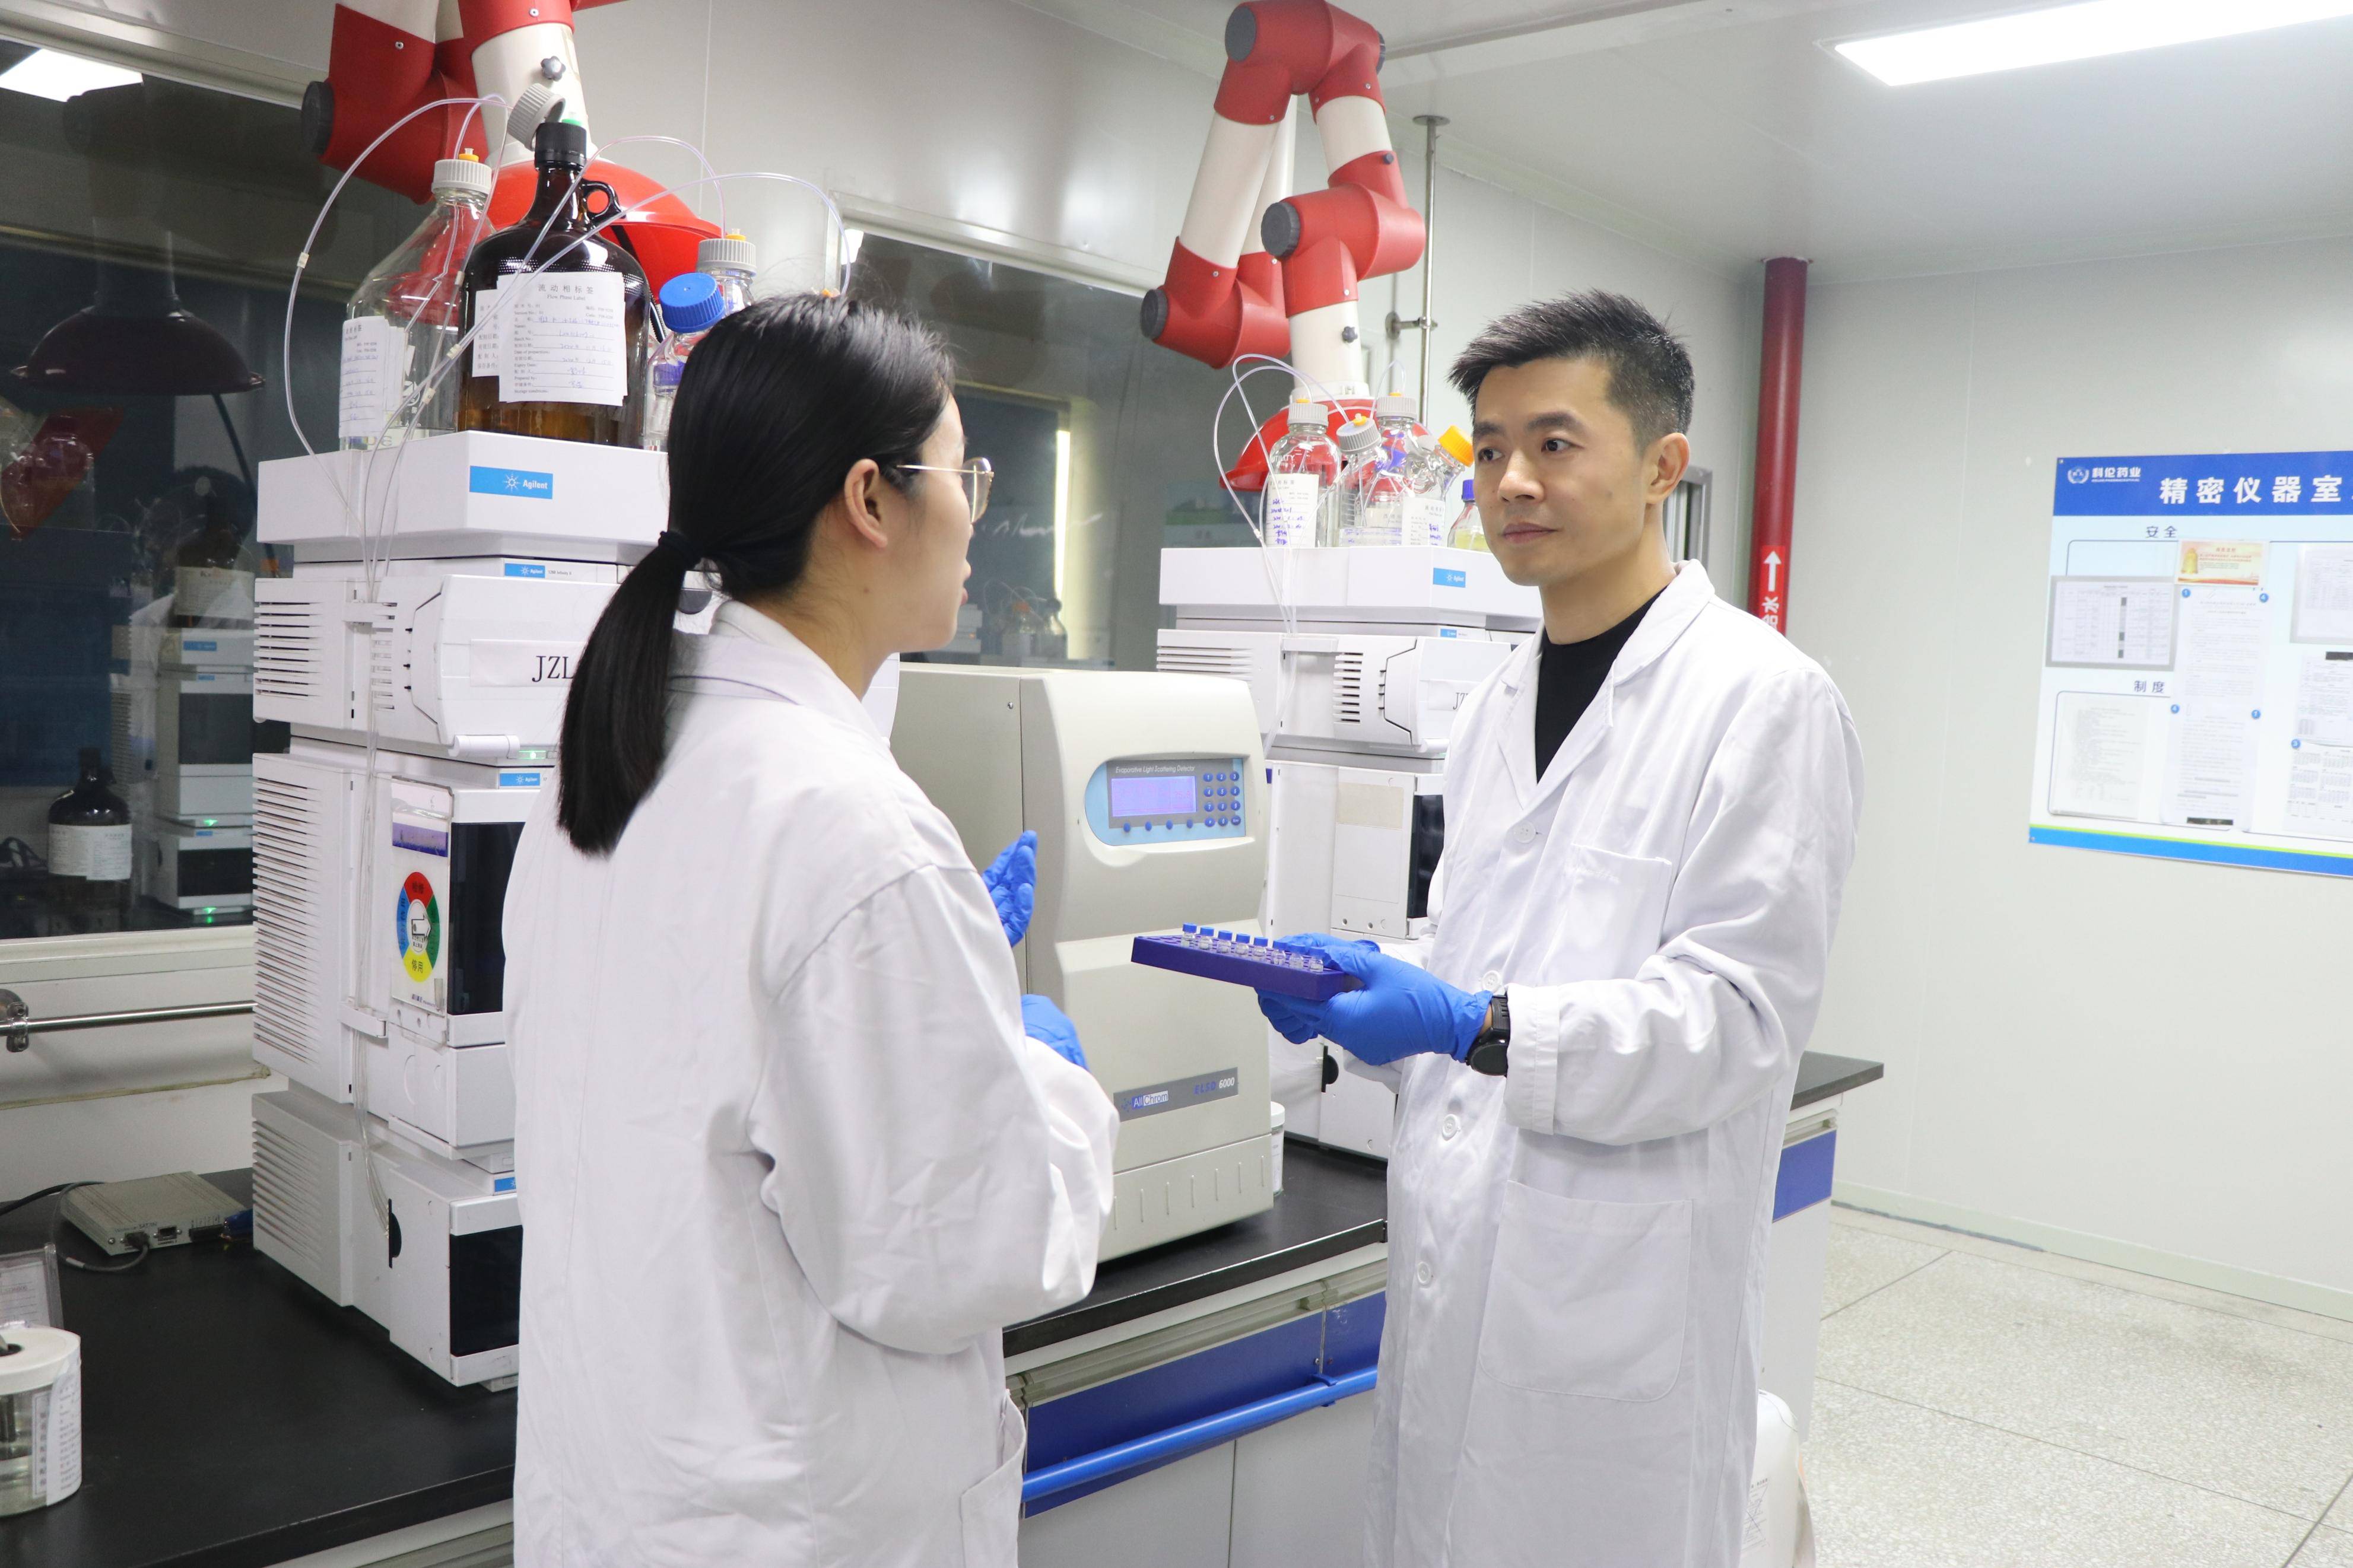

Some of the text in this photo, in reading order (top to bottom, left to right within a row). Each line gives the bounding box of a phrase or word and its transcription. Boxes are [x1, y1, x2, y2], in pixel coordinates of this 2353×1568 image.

[538, 284, 595, 294] 流动相标签
[2091, 467, 2141, 478] 科伦药业
[523, 479, 548, 491] Agilent
[2160, 475, 2353, 504] 精密仪器室
[2146, 526, 2177, 539] 安全
[2134, 680, 2165, 694] 制度
[1194, 1077, 1235, 1095] ELSD 6000
[1133, 1092, 1168, 1108] AllChrom
